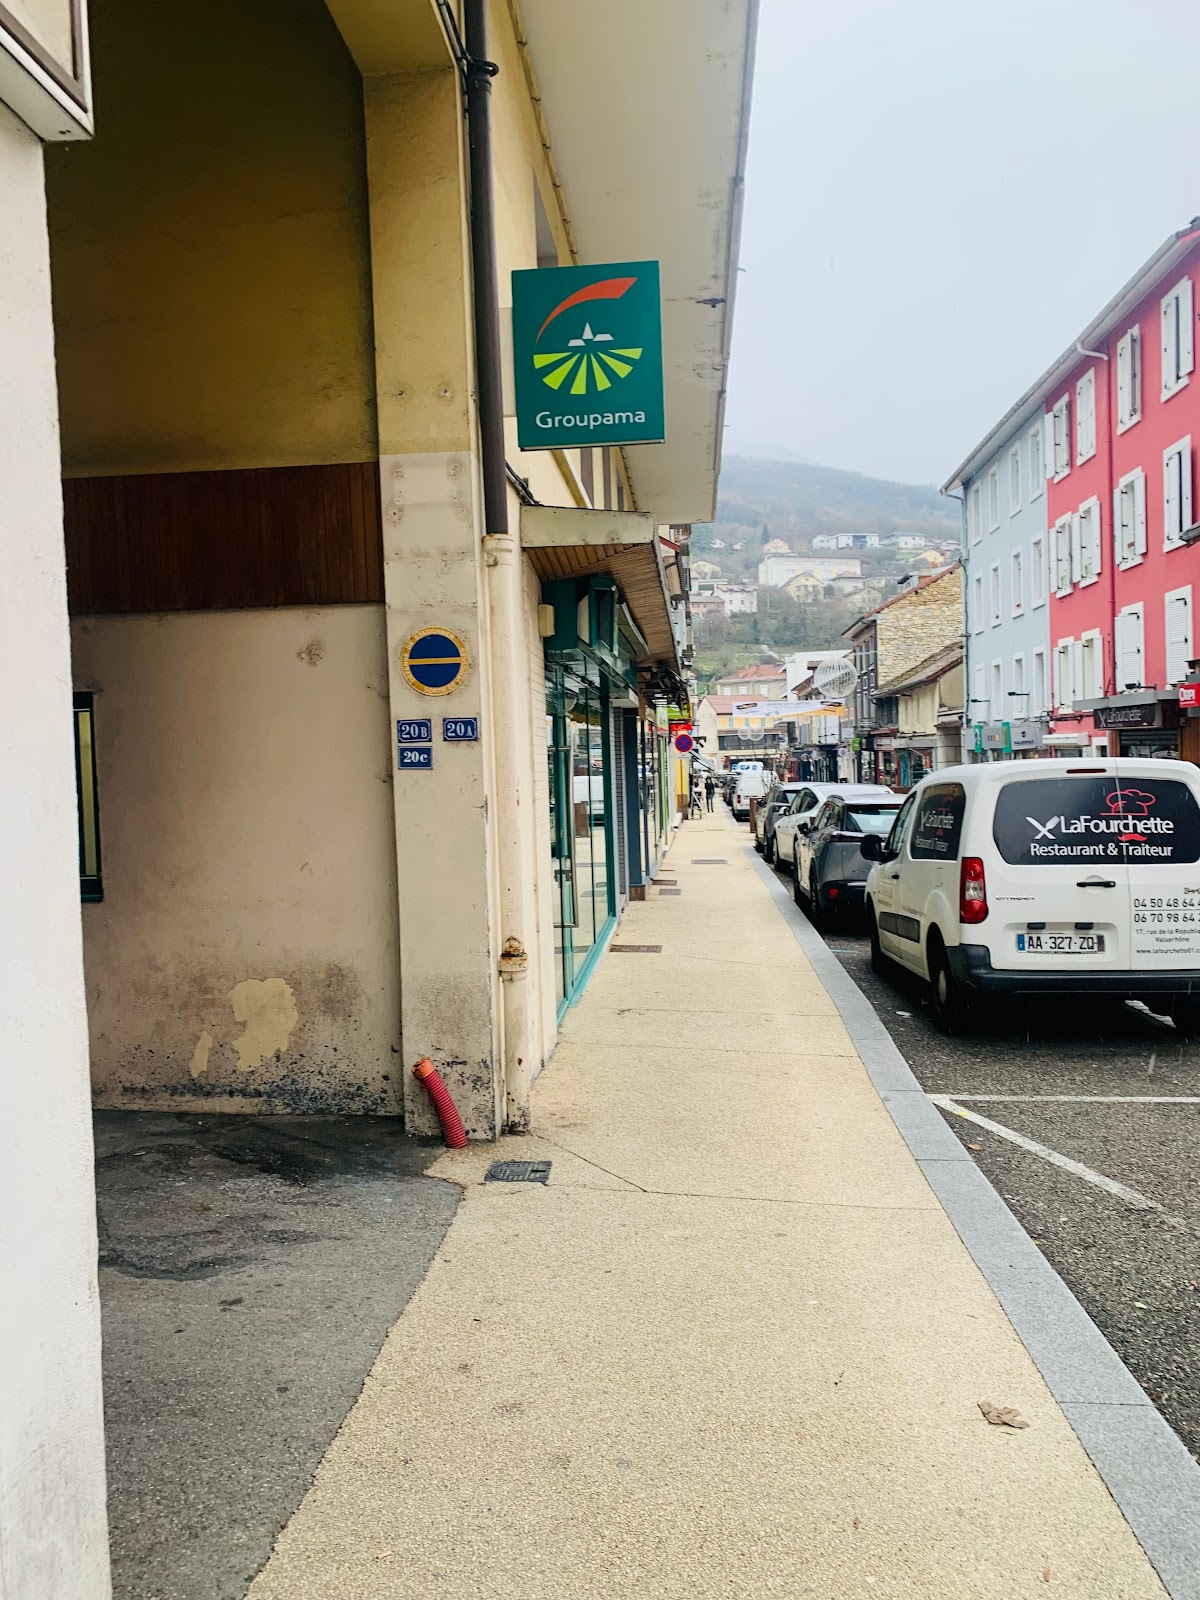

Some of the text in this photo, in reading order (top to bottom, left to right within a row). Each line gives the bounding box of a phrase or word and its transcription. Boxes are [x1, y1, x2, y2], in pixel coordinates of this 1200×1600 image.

[535, 411, 646, 430] Groupama
[1060, 814, 1175, 834] LaFourchette
[1030, 842, 1173, 857] Restaurant & Traiteur
[1134, 898, 1147, 908] 04
[1150, 898, 1163, 908] 50
[1166, 898, 1179, 908] 48
[1182, 898, 1195, 908] 64
[1134, 913, 1147, 923] 06
[1150, 913, 1163, 923] 70
[1166, 913, 1179, 923] 98
[1182, 913, 1195, 923] 64
